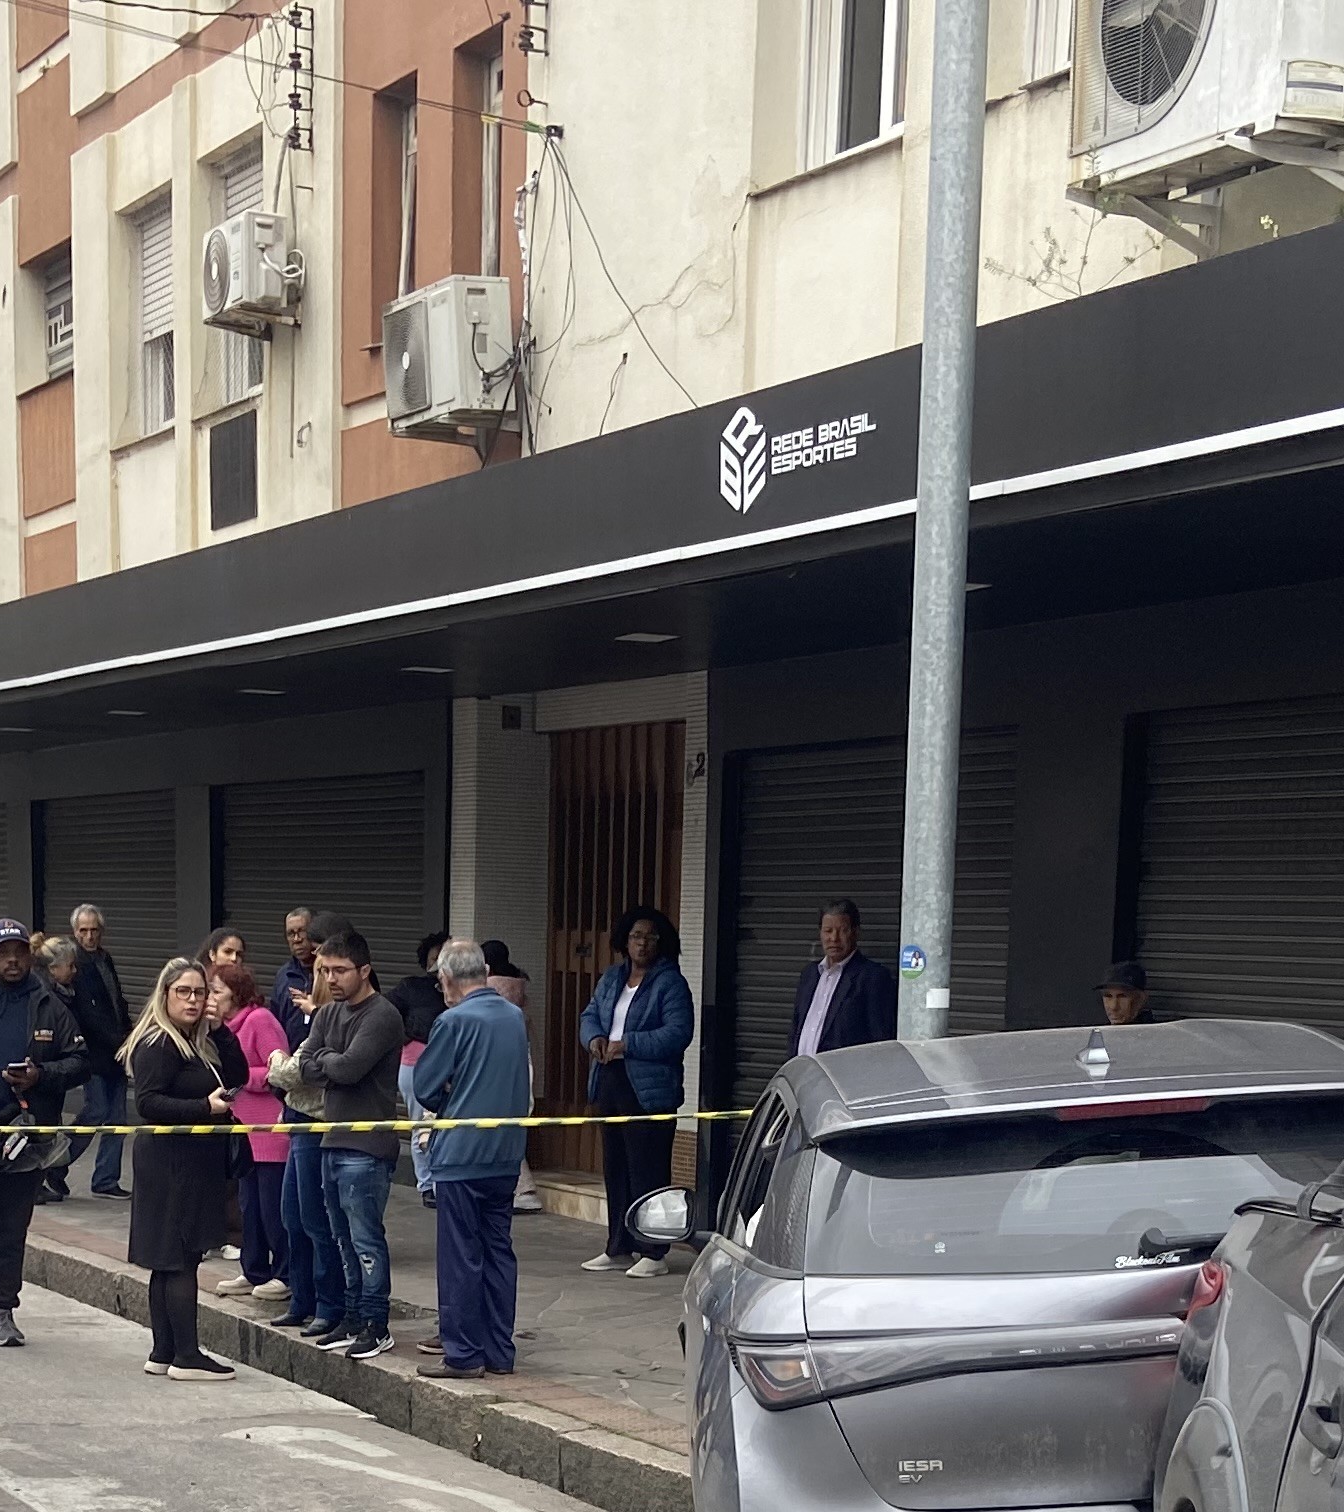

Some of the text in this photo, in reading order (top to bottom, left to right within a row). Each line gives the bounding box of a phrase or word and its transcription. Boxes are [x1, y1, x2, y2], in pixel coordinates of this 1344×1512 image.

[771, 412, 877, 456] REDE BRASIL
[771, 436, 857, 475] ESPORTES
[898, 1460, 943, 1472] IESA
[898, 1474, 923, 1484] EV
